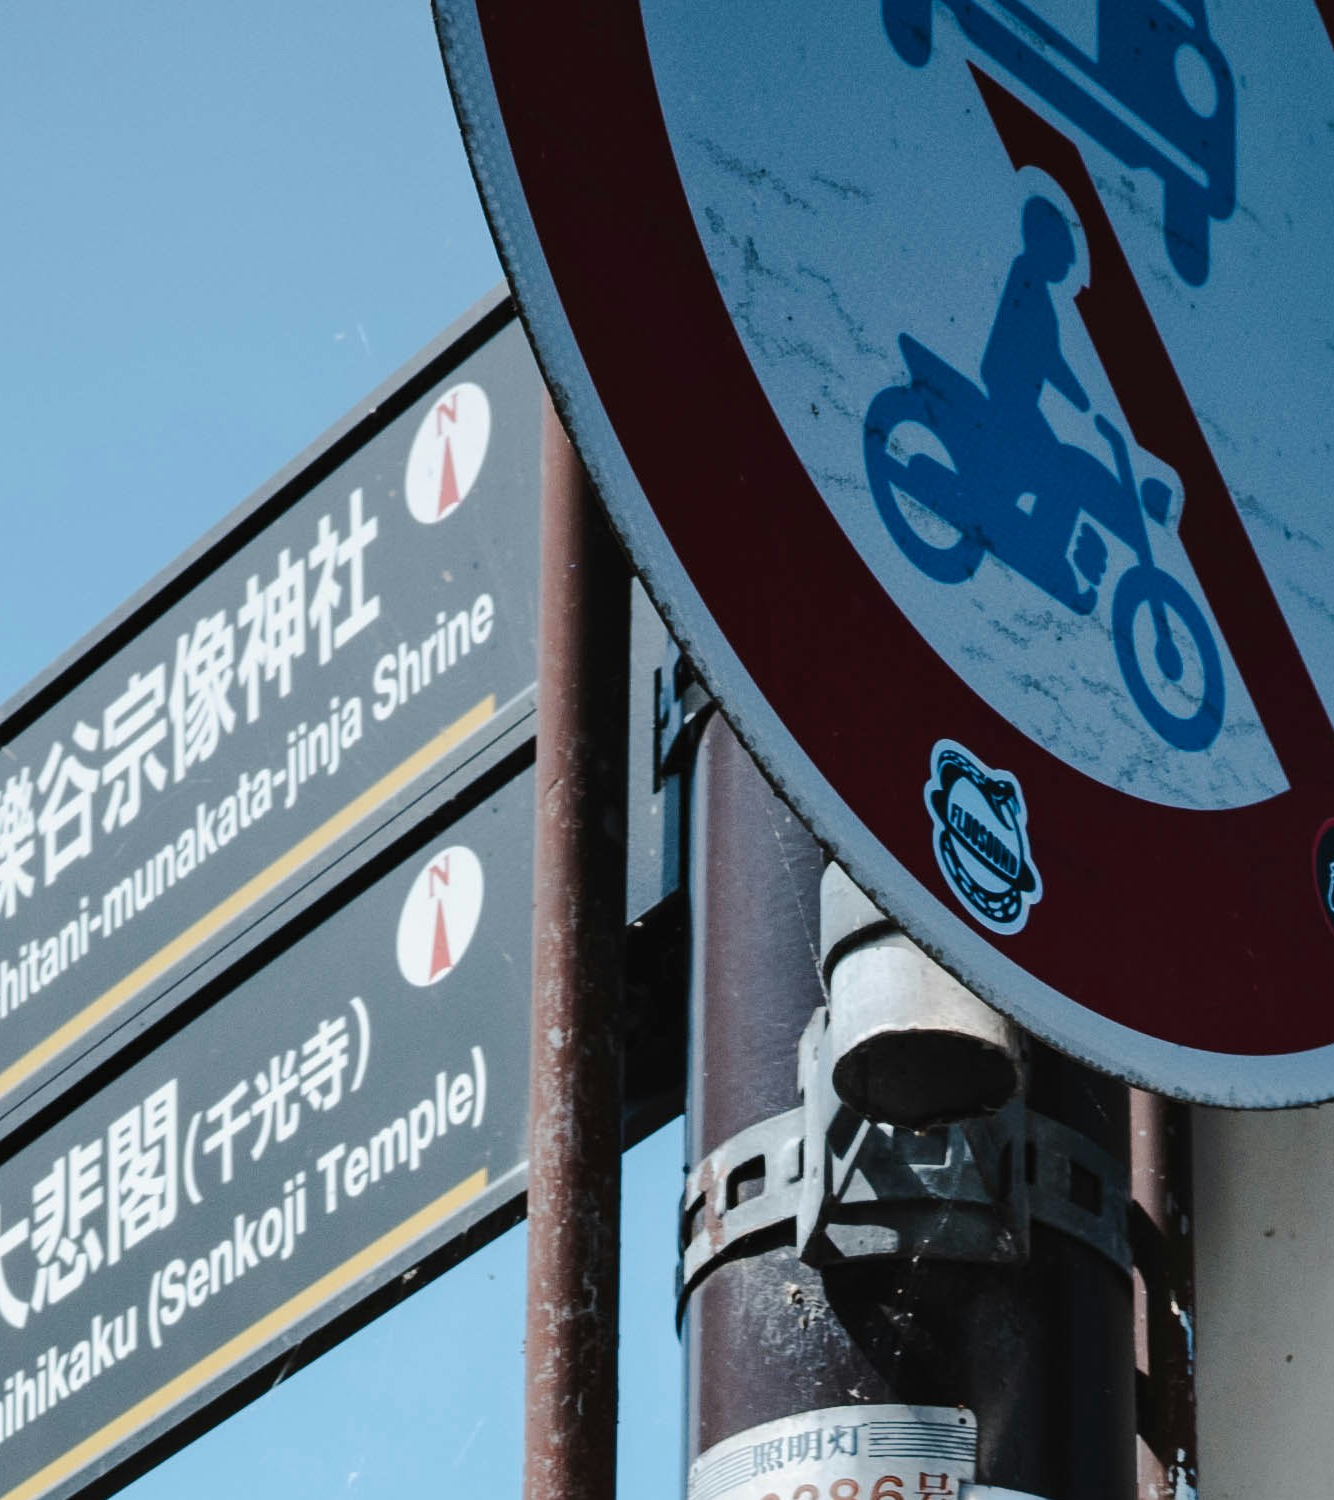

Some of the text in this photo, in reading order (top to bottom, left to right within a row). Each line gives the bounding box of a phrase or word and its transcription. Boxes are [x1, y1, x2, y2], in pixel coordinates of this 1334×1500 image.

[372, 592, 495, 721] Shrine
[148, 1183, 308, 1348] (Senkoji
[315, 1046, 488, 1214] Temple)
[750, 1423, 868, 1475] 照明灯
